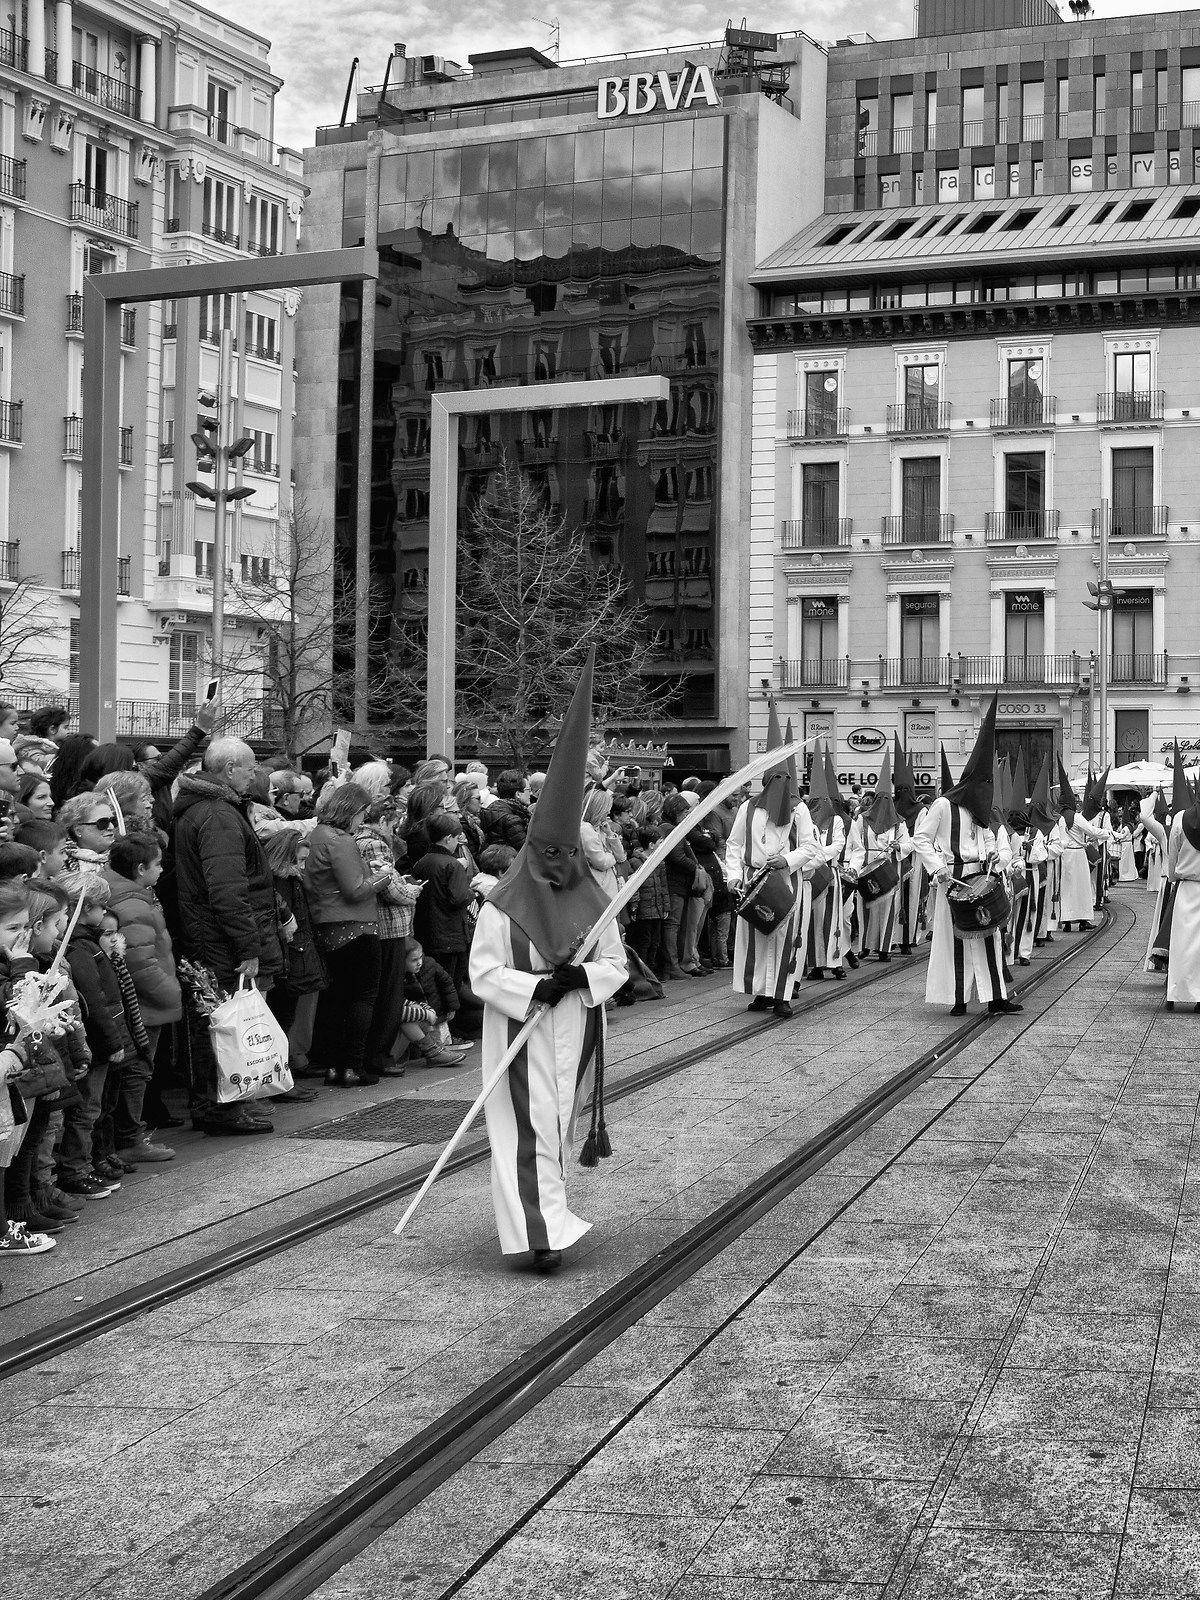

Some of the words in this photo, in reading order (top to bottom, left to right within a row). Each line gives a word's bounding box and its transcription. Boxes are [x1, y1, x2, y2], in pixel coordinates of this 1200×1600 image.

[597, 64, 720, 120] BBVA
[905, 600, 937, 610] seguros
[1011, 602, 1040, 611] mone
[808, 607, 834, 616] mone
[998, 703, 1031, 714] COSO
[1033, 703, 1047, 714] 33
[860, 773, 878, 786] LO
